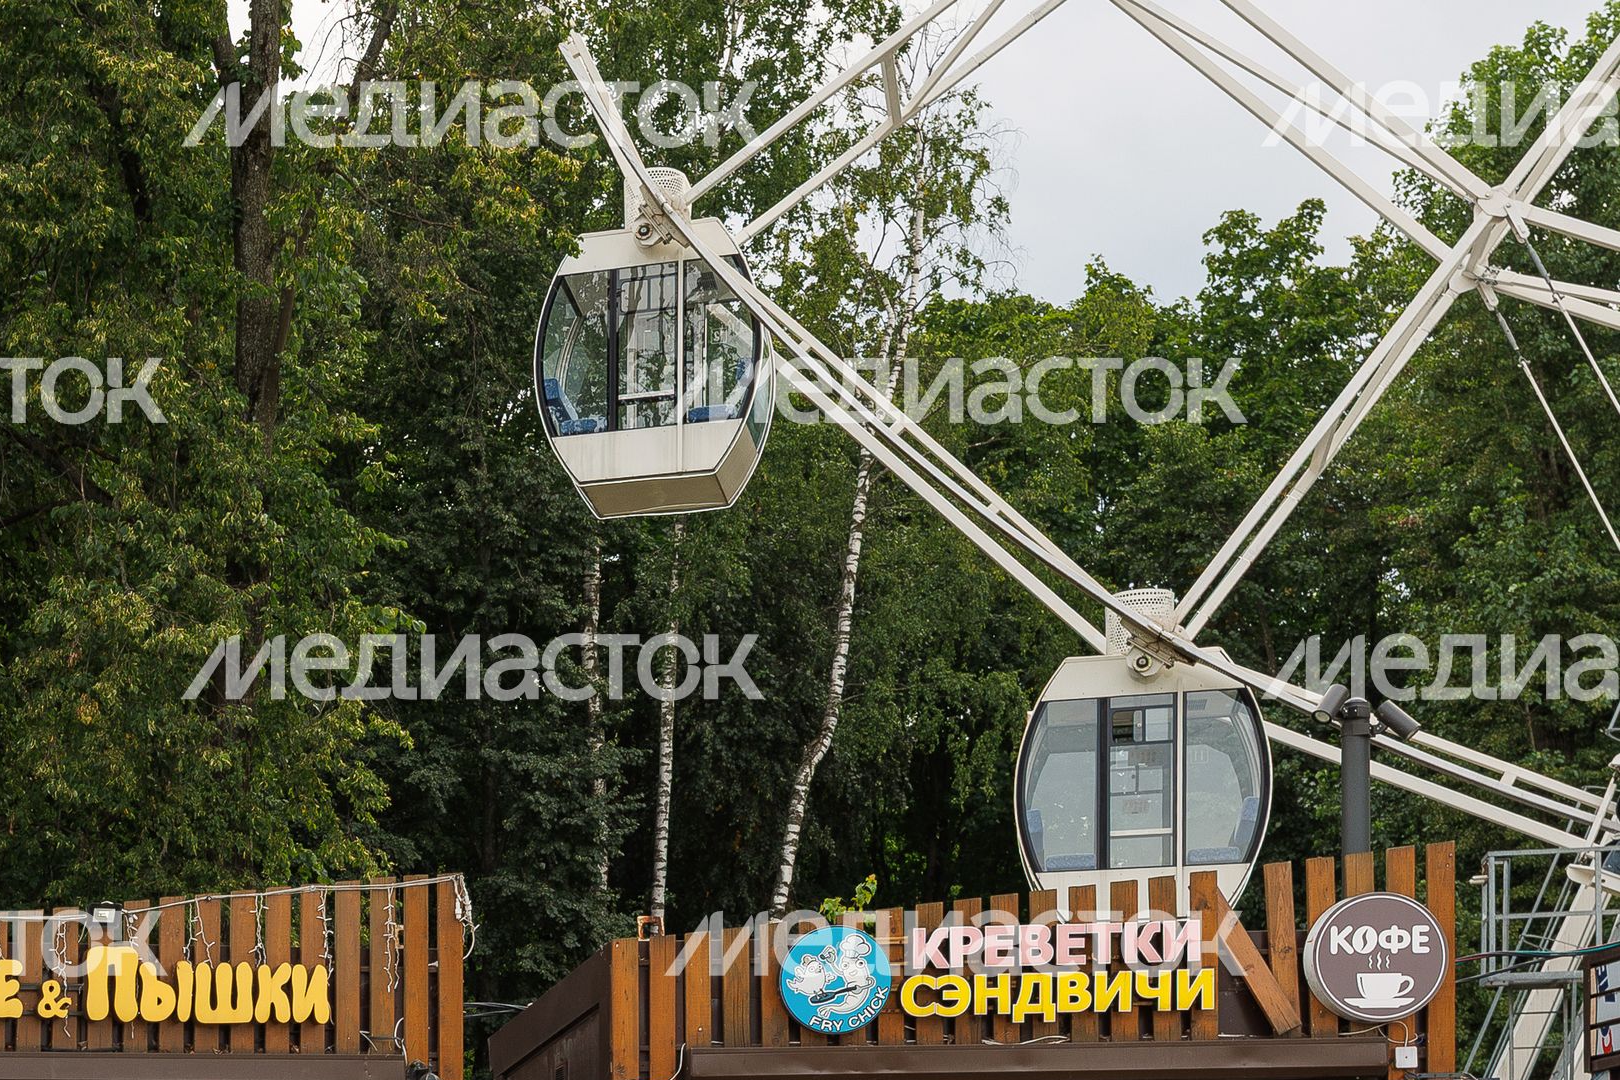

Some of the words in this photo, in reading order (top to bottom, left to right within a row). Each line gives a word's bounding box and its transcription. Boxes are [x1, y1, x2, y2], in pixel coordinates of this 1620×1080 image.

[913, 920, 1201, 970] КРЕВЕТКИ
[1330, 924, 1431, 955] КОФЕ
[38, 980, 71, 1018] &
[809, 1016, 843, 1031] FRY
[849, 986, 889, 1027] CHICK
[900, 969, 1216, 1023] СЭНДВИЧИ
